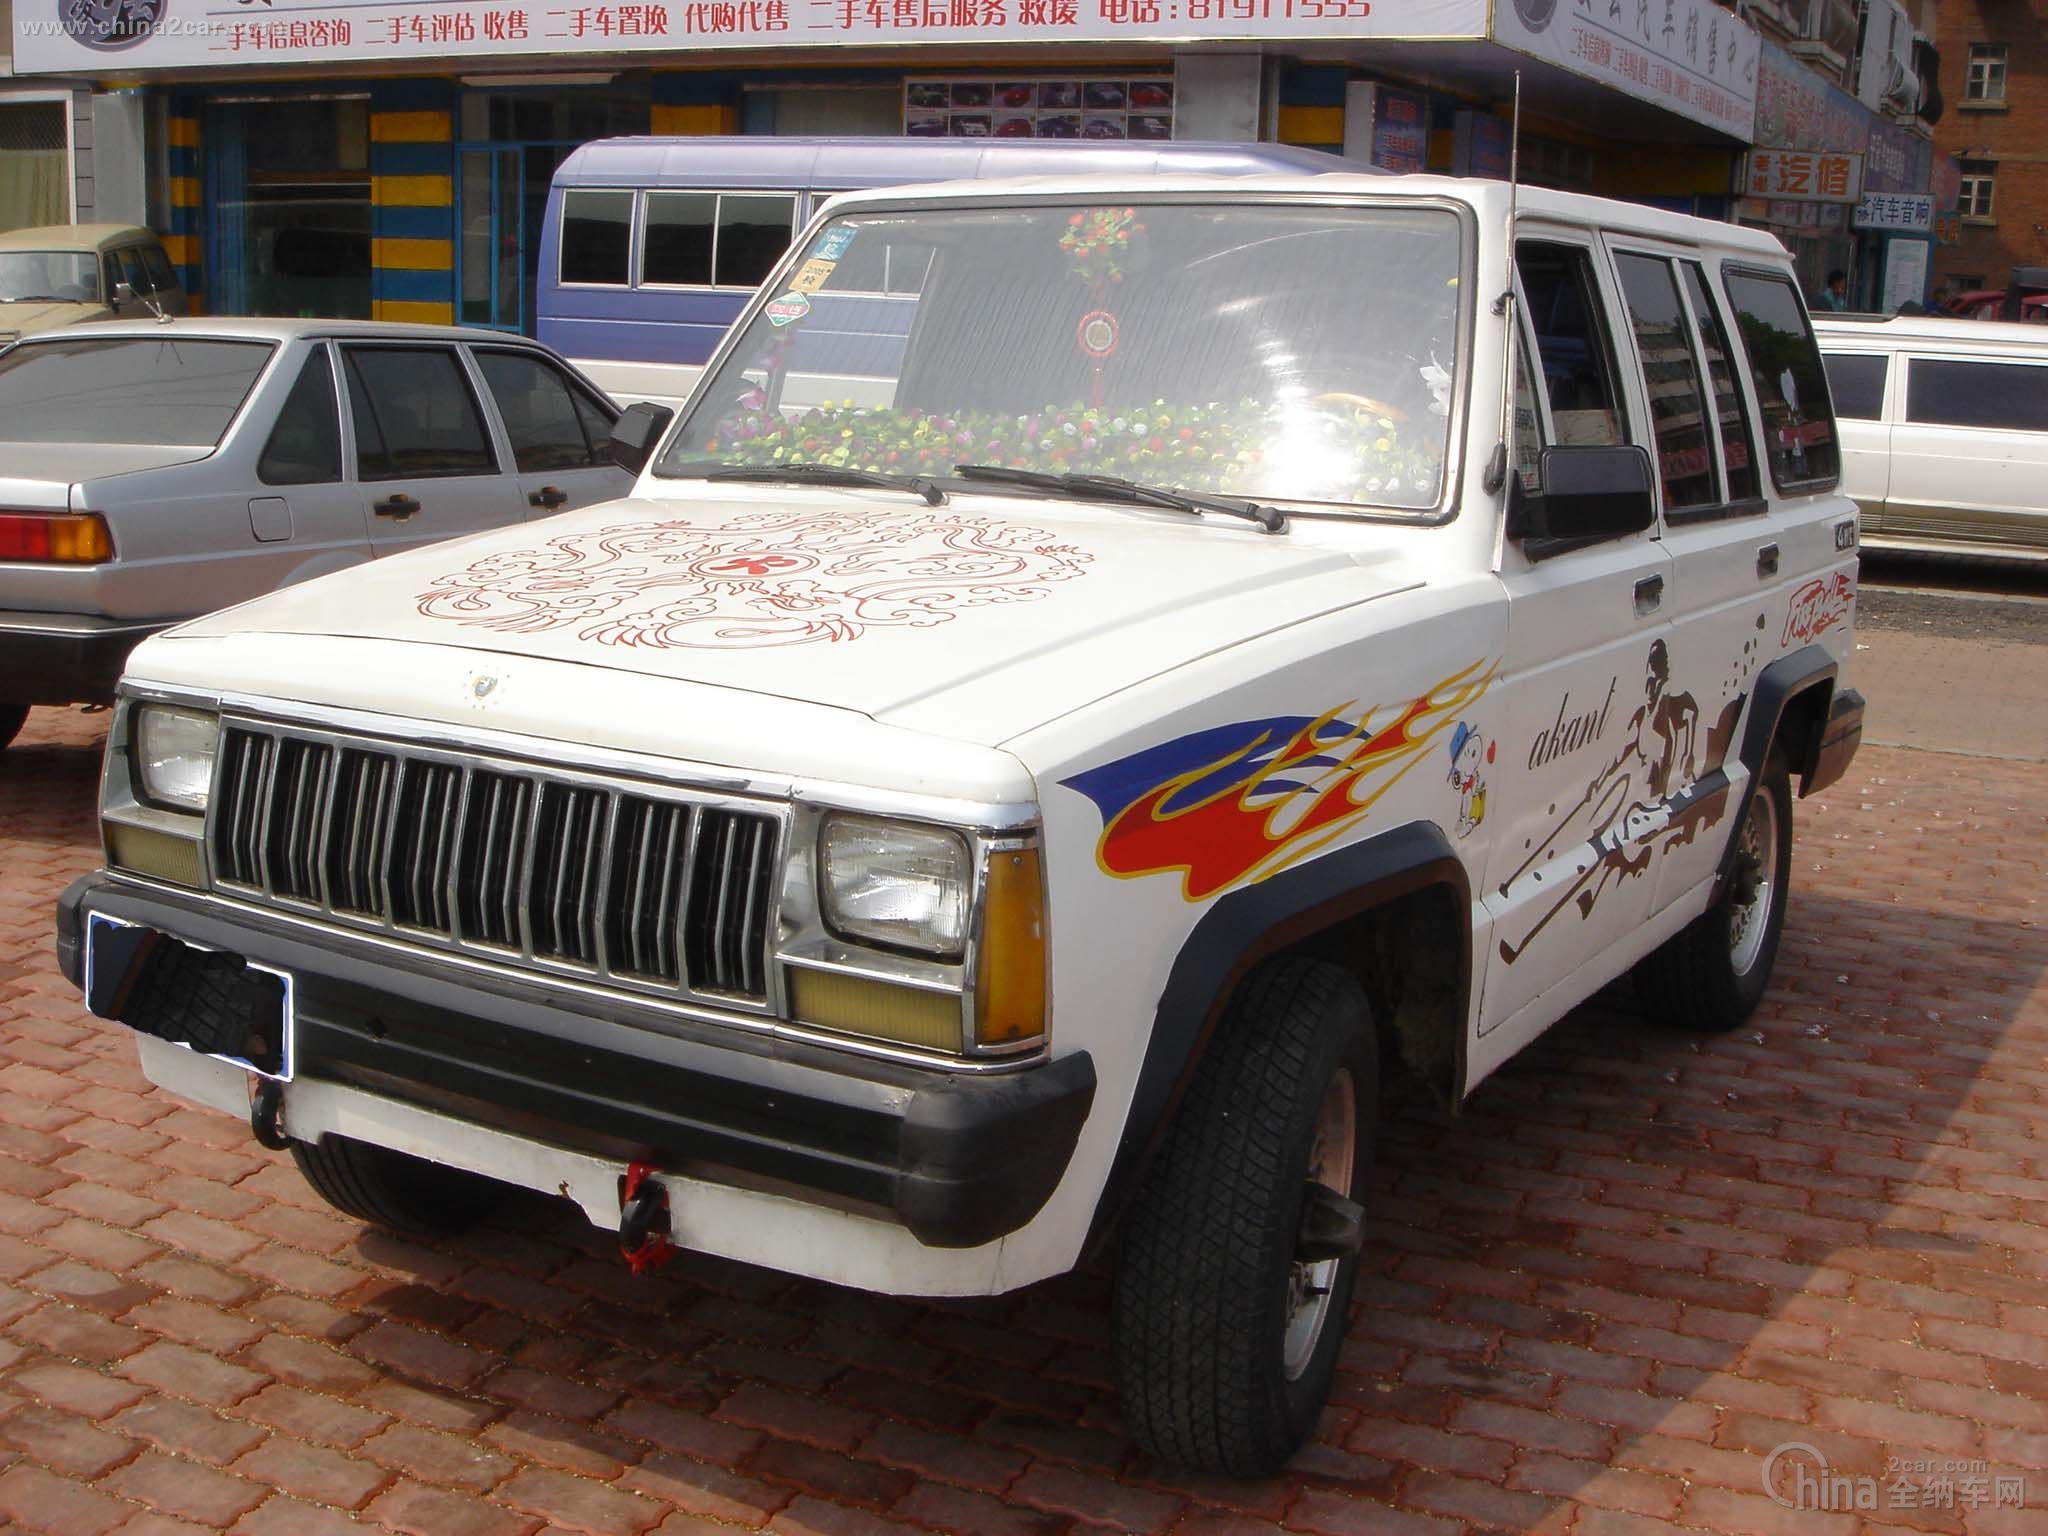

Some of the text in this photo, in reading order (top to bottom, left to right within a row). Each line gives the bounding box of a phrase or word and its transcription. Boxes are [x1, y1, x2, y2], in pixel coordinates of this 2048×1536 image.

[365, 12, 475, 44] 二手车评估
[484, 10, 529, 41] 收售
[545, 5, 669, 38] 二手车置换
[684, 1, 790, 34] 代购代售
[807, 0, 1008, 29] 二手车售后服务
[1018, 0, 1078, 25] 救援
[1872, 195, 1930, 225] 汽车音响
